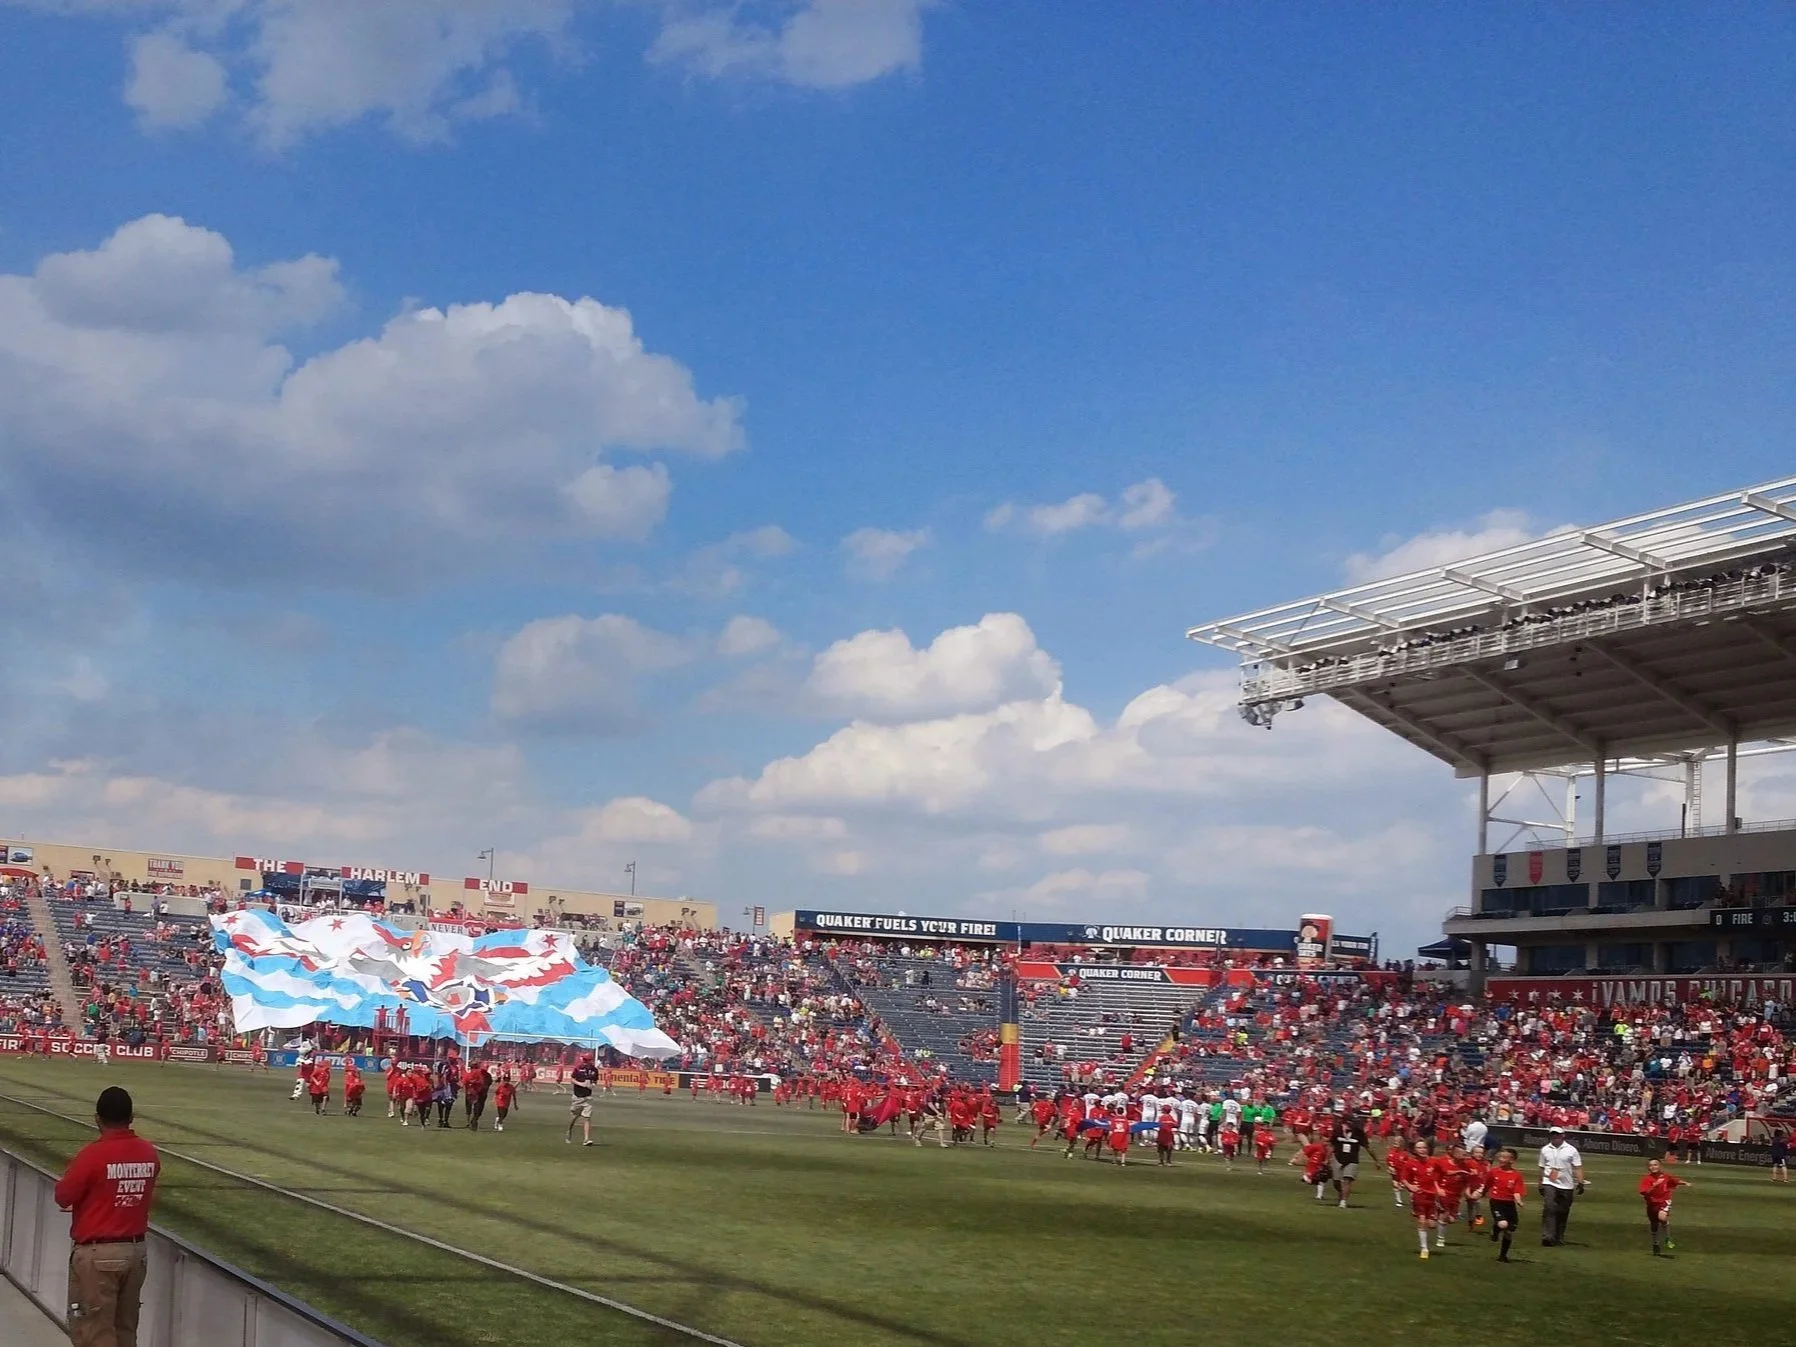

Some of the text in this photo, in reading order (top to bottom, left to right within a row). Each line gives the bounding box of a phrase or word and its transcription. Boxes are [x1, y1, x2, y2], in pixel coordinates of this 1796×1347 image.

[253, 859, 513, 893] THE HARLEM END
[816, 914, 996, 936] QUAKER FUELS YOUR FIRE!
[1732, 913, 1753, 925] FIRE
[431, 923, 463, 934] NEVER
[1102, 926, 1227, 945] QUAKER CORNER
[1079, 968, 1162, 981] QUAKER CORNER
[116, 1045, 154, 1057] CLUB
[171, 1049, 206, 1058] CHIPOTLE
[654, 1075, 675, 1085] TIE
[1706, 1147, 1736, 1160] Ahorre
[117, 1180, 146, 1193] EVENT
